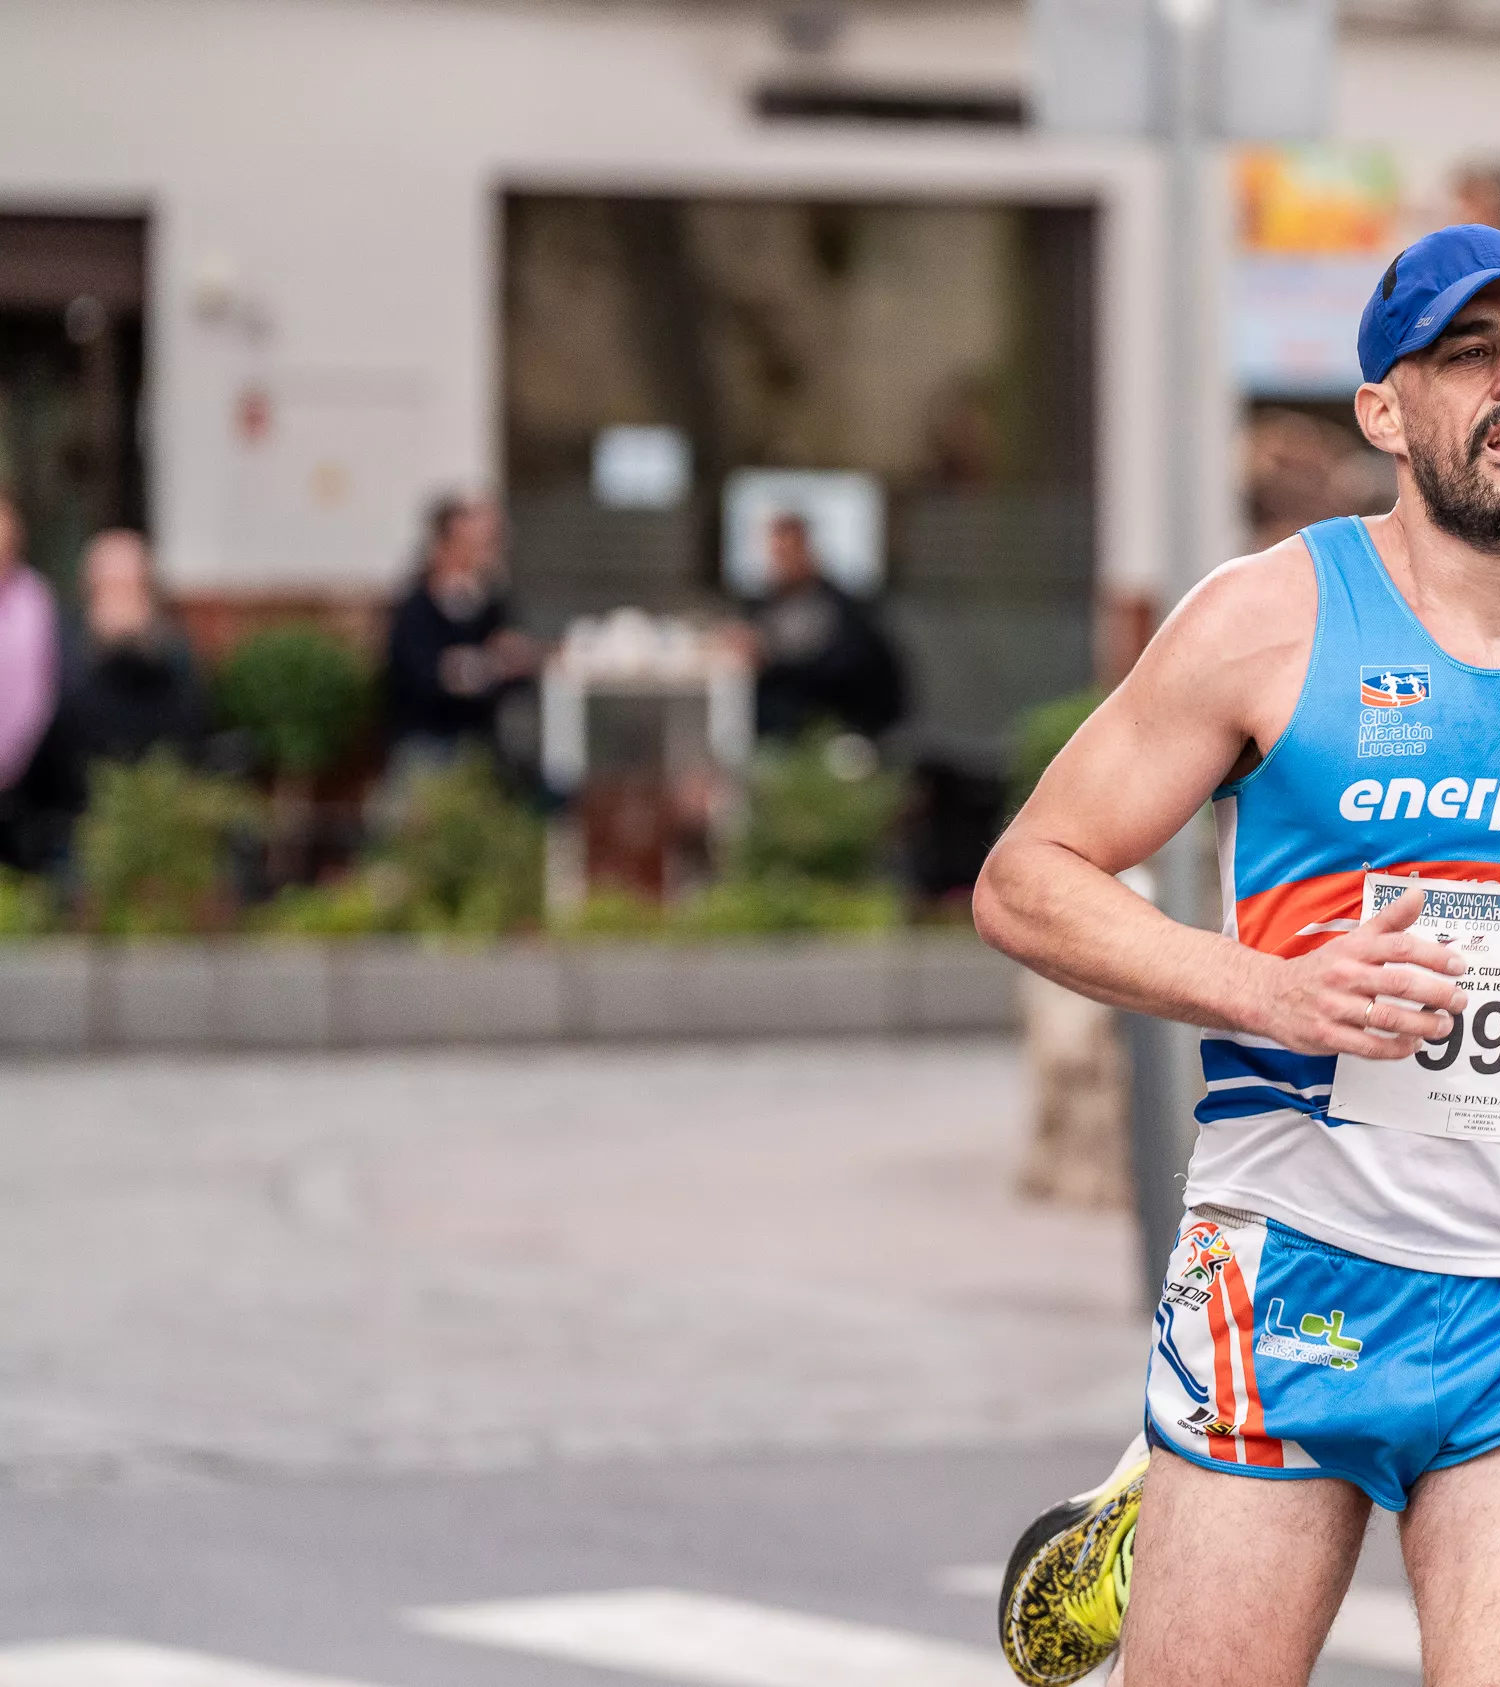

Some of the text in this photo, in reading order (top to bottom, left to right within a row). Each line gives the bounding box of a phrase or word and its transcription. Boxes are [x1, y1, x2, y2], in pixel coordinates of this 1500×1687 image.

[1360, 708, 1403, 726] Club
[1359, 722, 1433, 742] Maratón
[1357, 739, 1427, 758] Lucena
[1432, 891, 1500, 908] PROVINCIAL
[1445, 920, 1458, 930] DE
[1455, 981, 1474, 992] POR
[1476, 982, 1490, 992] LA
[1427, 1091, 1462, 1104] JESUS
